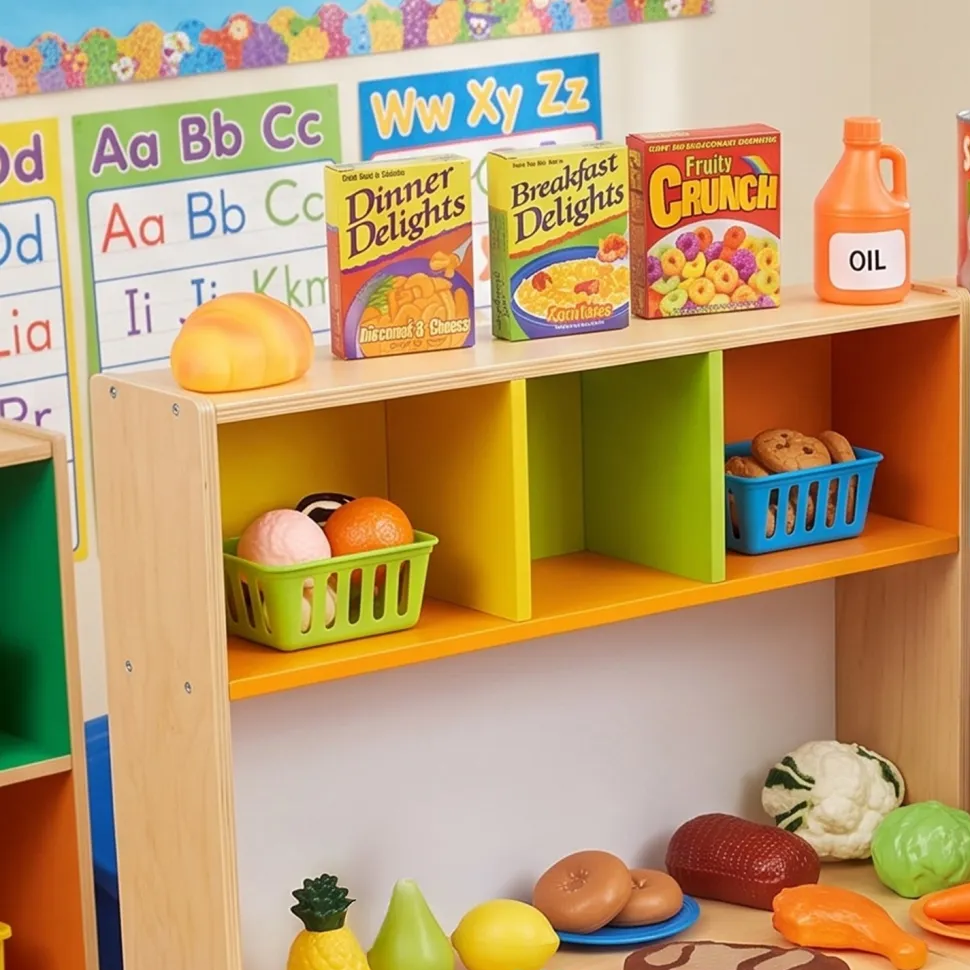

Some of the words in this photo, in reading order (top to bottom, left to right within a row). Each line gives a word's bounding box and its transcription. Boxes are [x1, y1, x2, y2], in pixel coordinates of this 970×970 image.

[371, 87, 455, 139] Ww
[467, 77, 523, 134] Xy
[537, 69, 589, 117] Zz
[91, 126, 160, 175] Aa
[180, 110, 243, 163] Bb
[262, 104, 322, 150] Cc
[686, 154, 732, 178] Fruity
[345, 166, 454, 227] Dinner
[511, 153, 619, 209] Breakfast
[649, 163, 778, 229] CRUNCH
[102, 202, 165, 253] Aa
[187, 189, 246, 240] Bb
[265, 179, 324, 226] Cc
[346, 194, 466, 260] Delights
[513, 182, 625, 245] Delights
[849, 249, 886, 271] OIL
[125, 288, 152, 336] Ii
